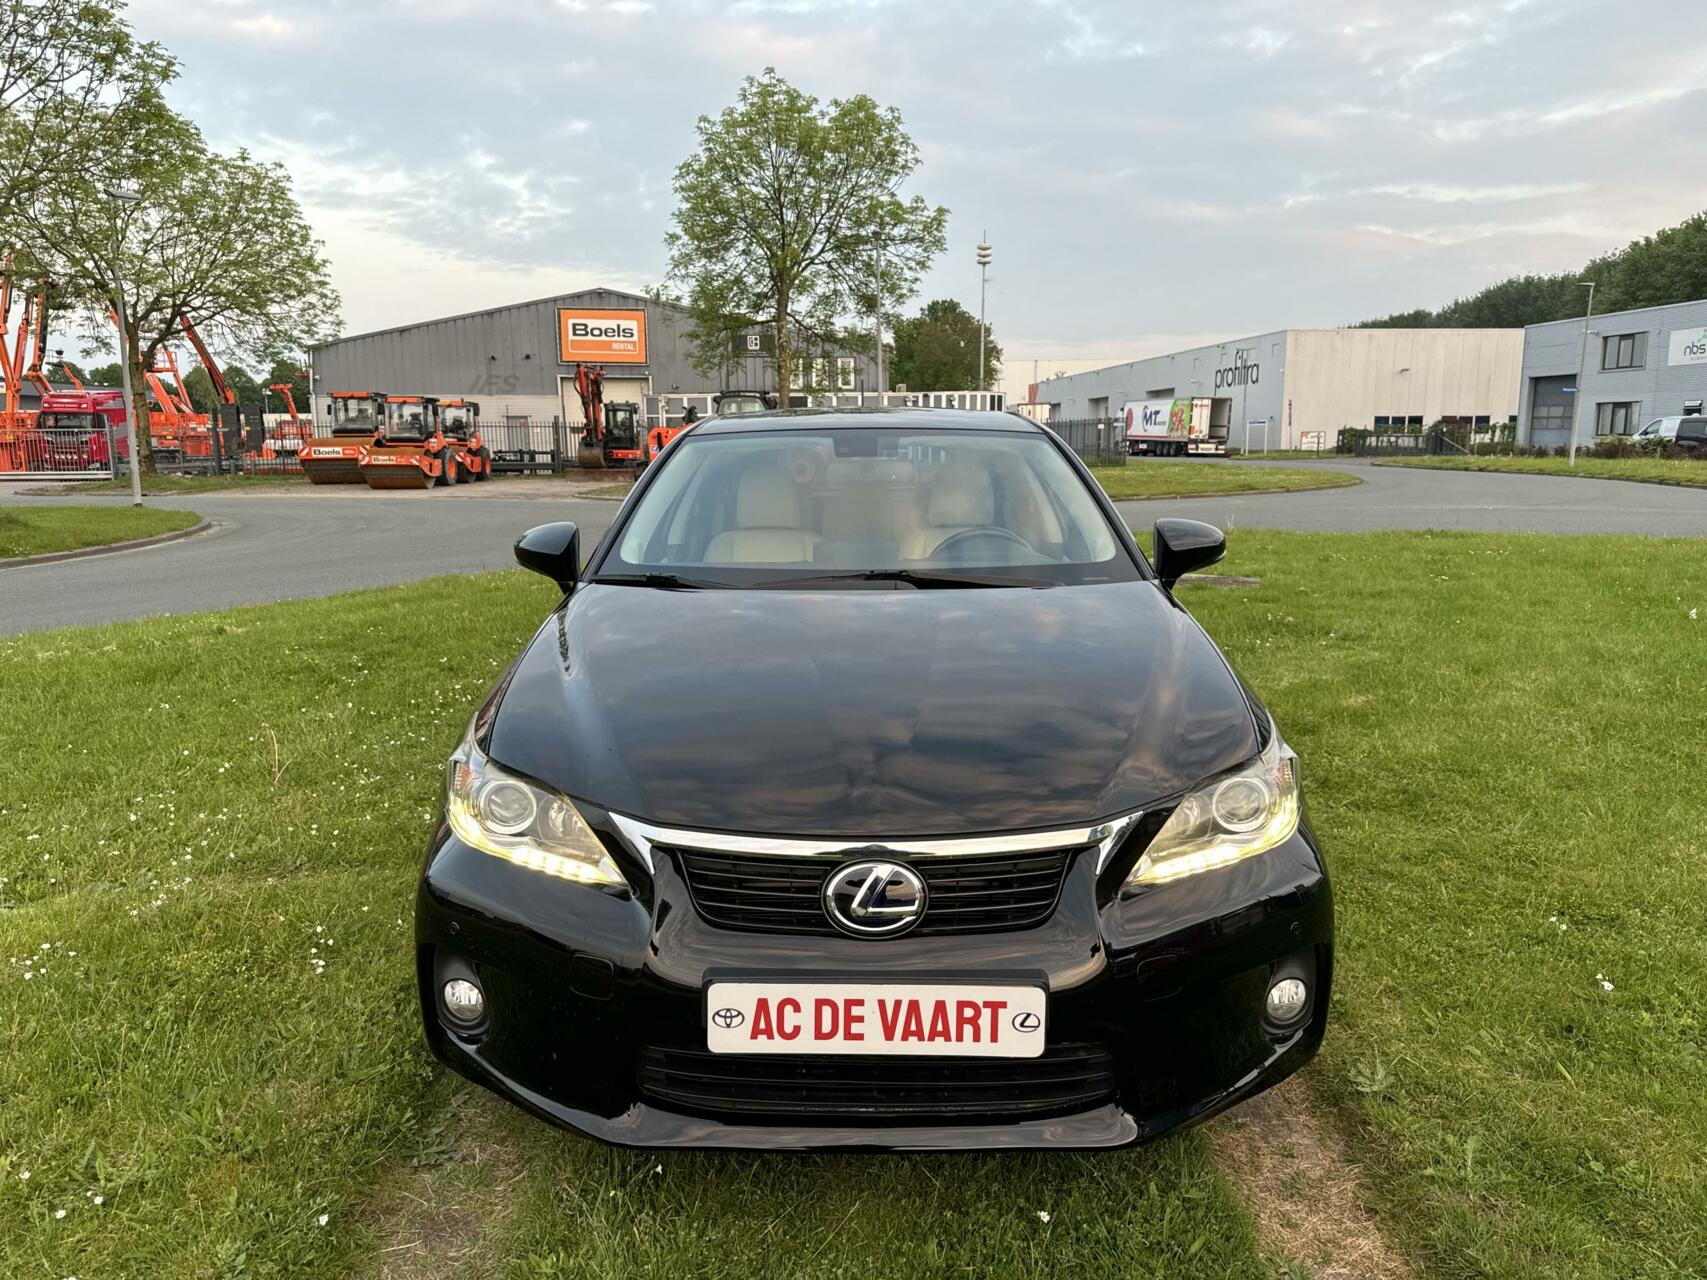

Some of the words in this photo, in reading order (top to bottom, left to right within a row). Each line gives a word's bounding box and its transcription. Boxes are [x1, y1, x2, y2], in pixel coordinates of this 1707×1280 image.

[572, 322, 635, 338] Boels
[612, 342, 635, 352] RENTAL
[1684, 340, 1706, 356] nbs
[1214, 350, 1259, 397] profiltra
[313, 448, 342, 456] Boels
[749, 997, 801, 1040] AC
[814, 998, 865, 1041] DE
[877, 999, 1007, 1043] VAART
